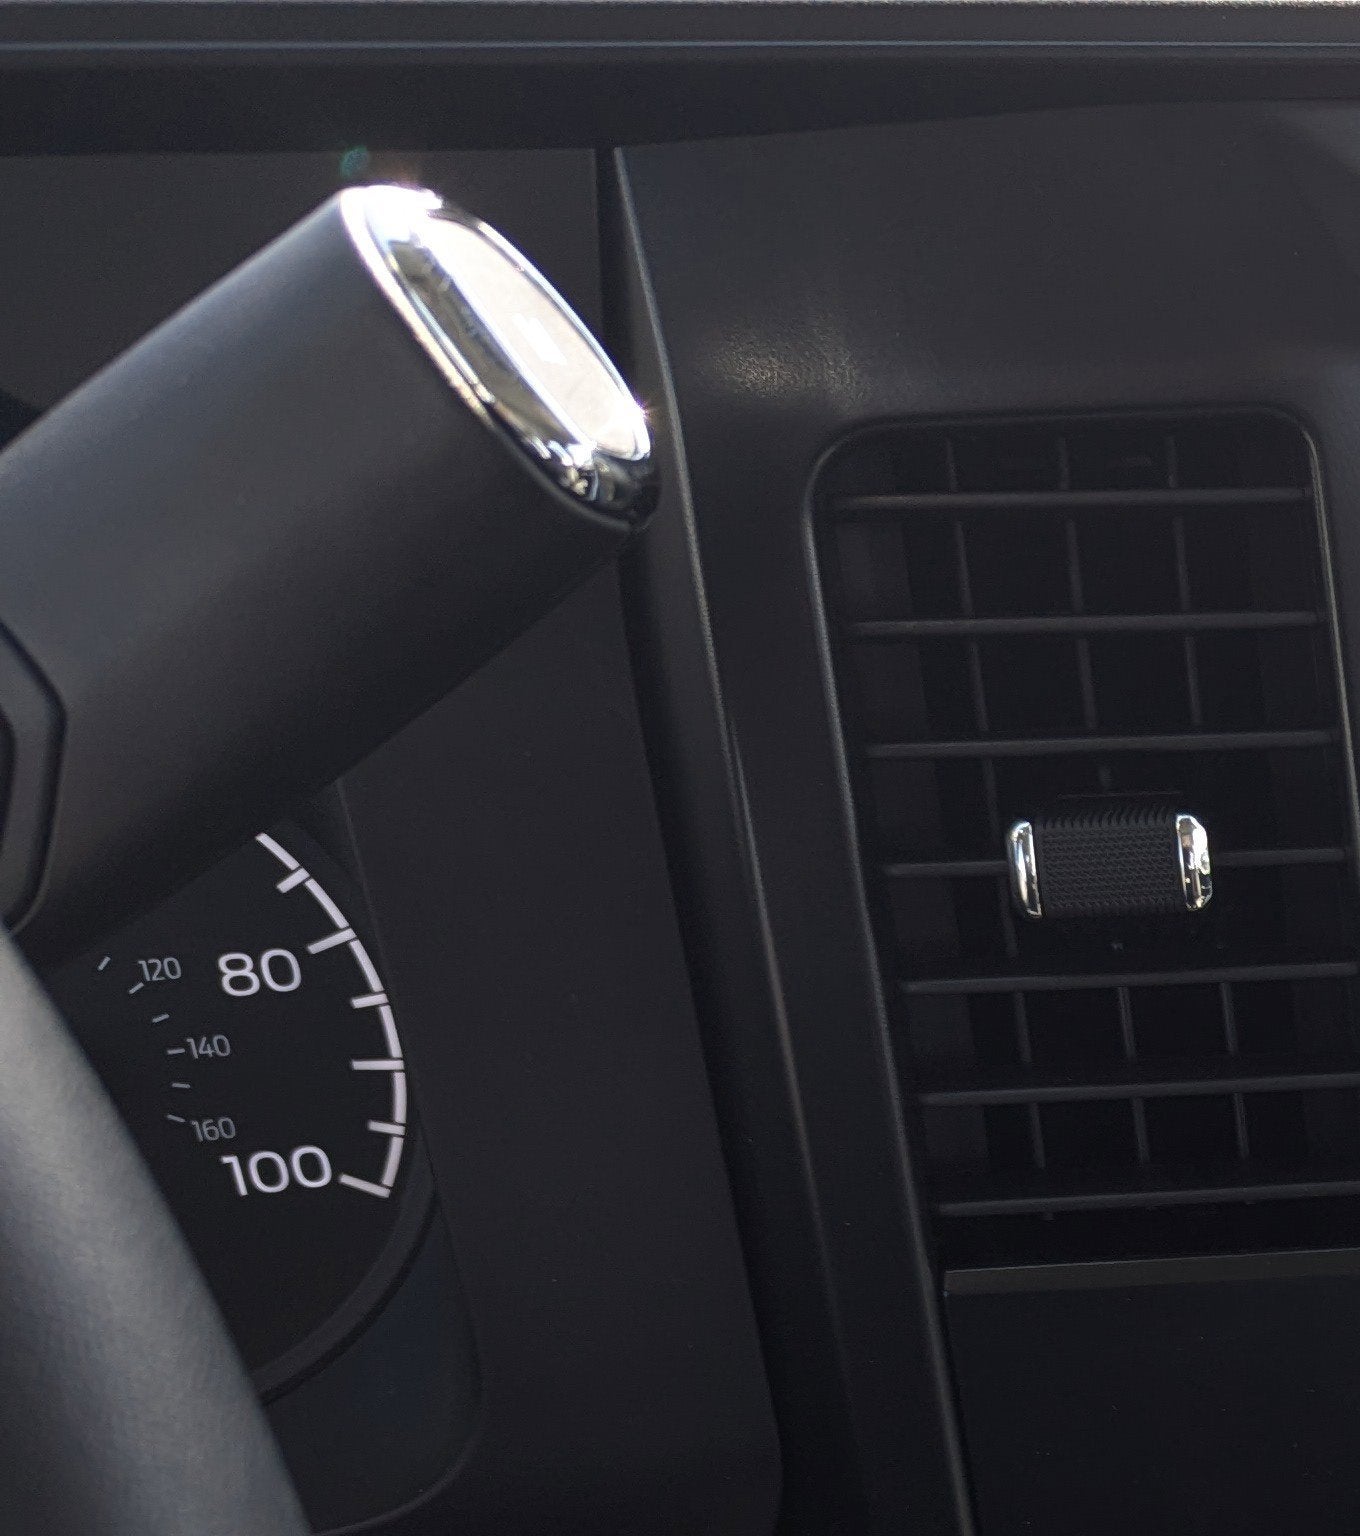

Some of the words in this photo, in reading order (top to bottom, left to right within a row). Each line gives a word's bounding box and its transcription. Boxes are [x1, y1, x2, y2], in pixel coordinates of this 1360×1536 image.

[138, 957, 182, 982] 120
[217, 948, 302, 997] 80
[186, 1034, 231, 1060] 140
[191, 1117, 236, 1143] 160
[221, 1145, 332, 1196] 100
